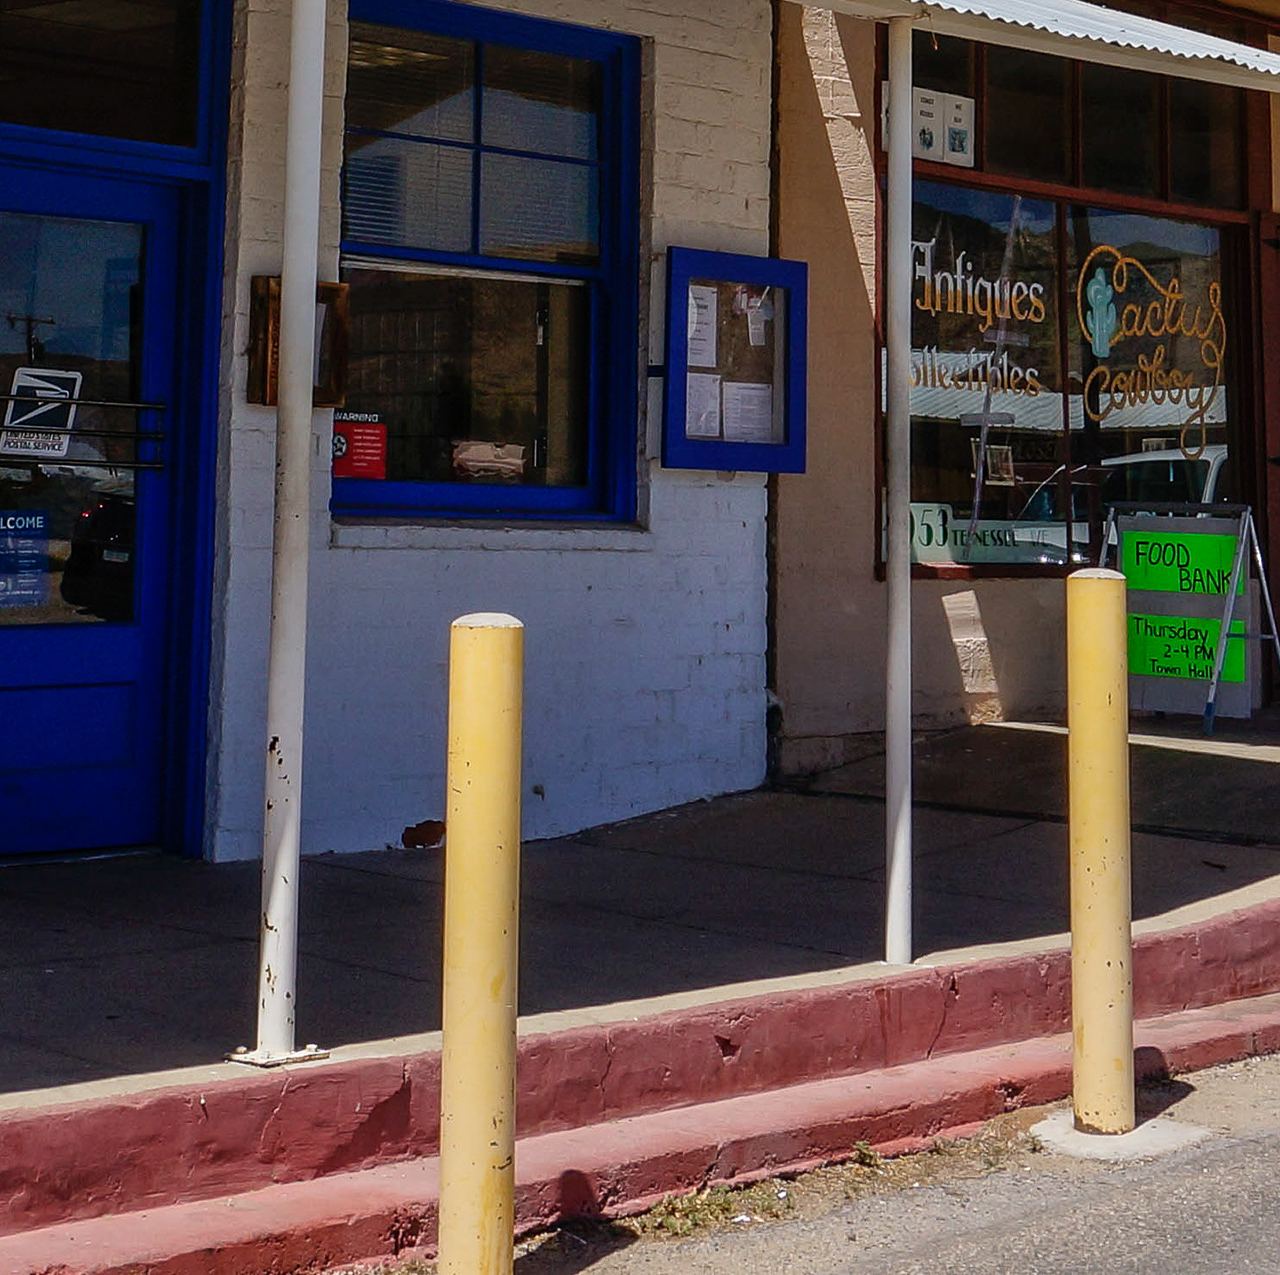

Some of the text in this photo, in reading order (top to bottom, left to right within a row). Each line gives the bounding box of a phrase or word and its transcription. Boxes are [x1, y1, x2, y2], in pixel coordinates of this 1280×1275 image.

[911, 238, 1046, 333] Antiques
[1077, 245, 1223, 348] Cactus
[1084, 344, 1222, 460] Cowboy
[335, 412, 379, 423] WARNING
[1134, 540, 1190, 568] FOOD
[1178, 567, 1232, 595] BANK
[1133, 616, 1209, 643] Thursday
[1163, 644, 1215, 661] 2-4 PM
[1149, 659, 1214, 680] Town Hall
